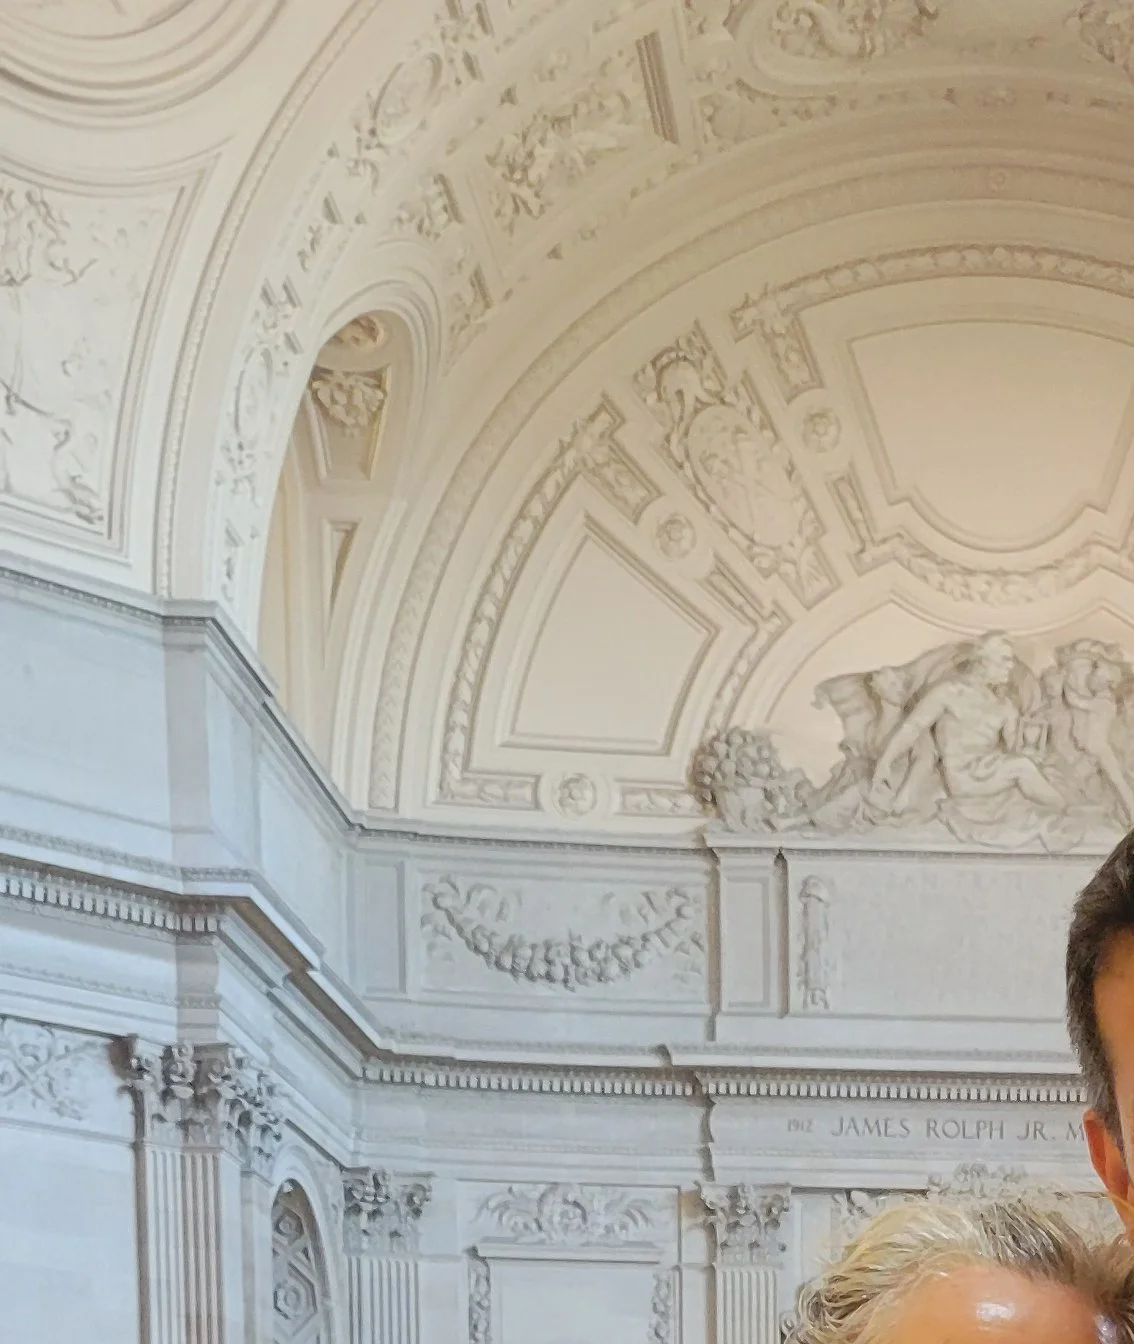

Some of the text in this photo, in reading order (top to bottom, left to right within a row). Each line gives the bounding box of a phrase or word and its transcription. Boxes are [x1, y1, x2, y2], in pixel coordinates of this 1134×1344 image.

[831, 1116, 911, 1139] JAMES
[926, 1118, 1004, 1141] ROLPH
[1016, 1121, 1056, 1142] JR.
